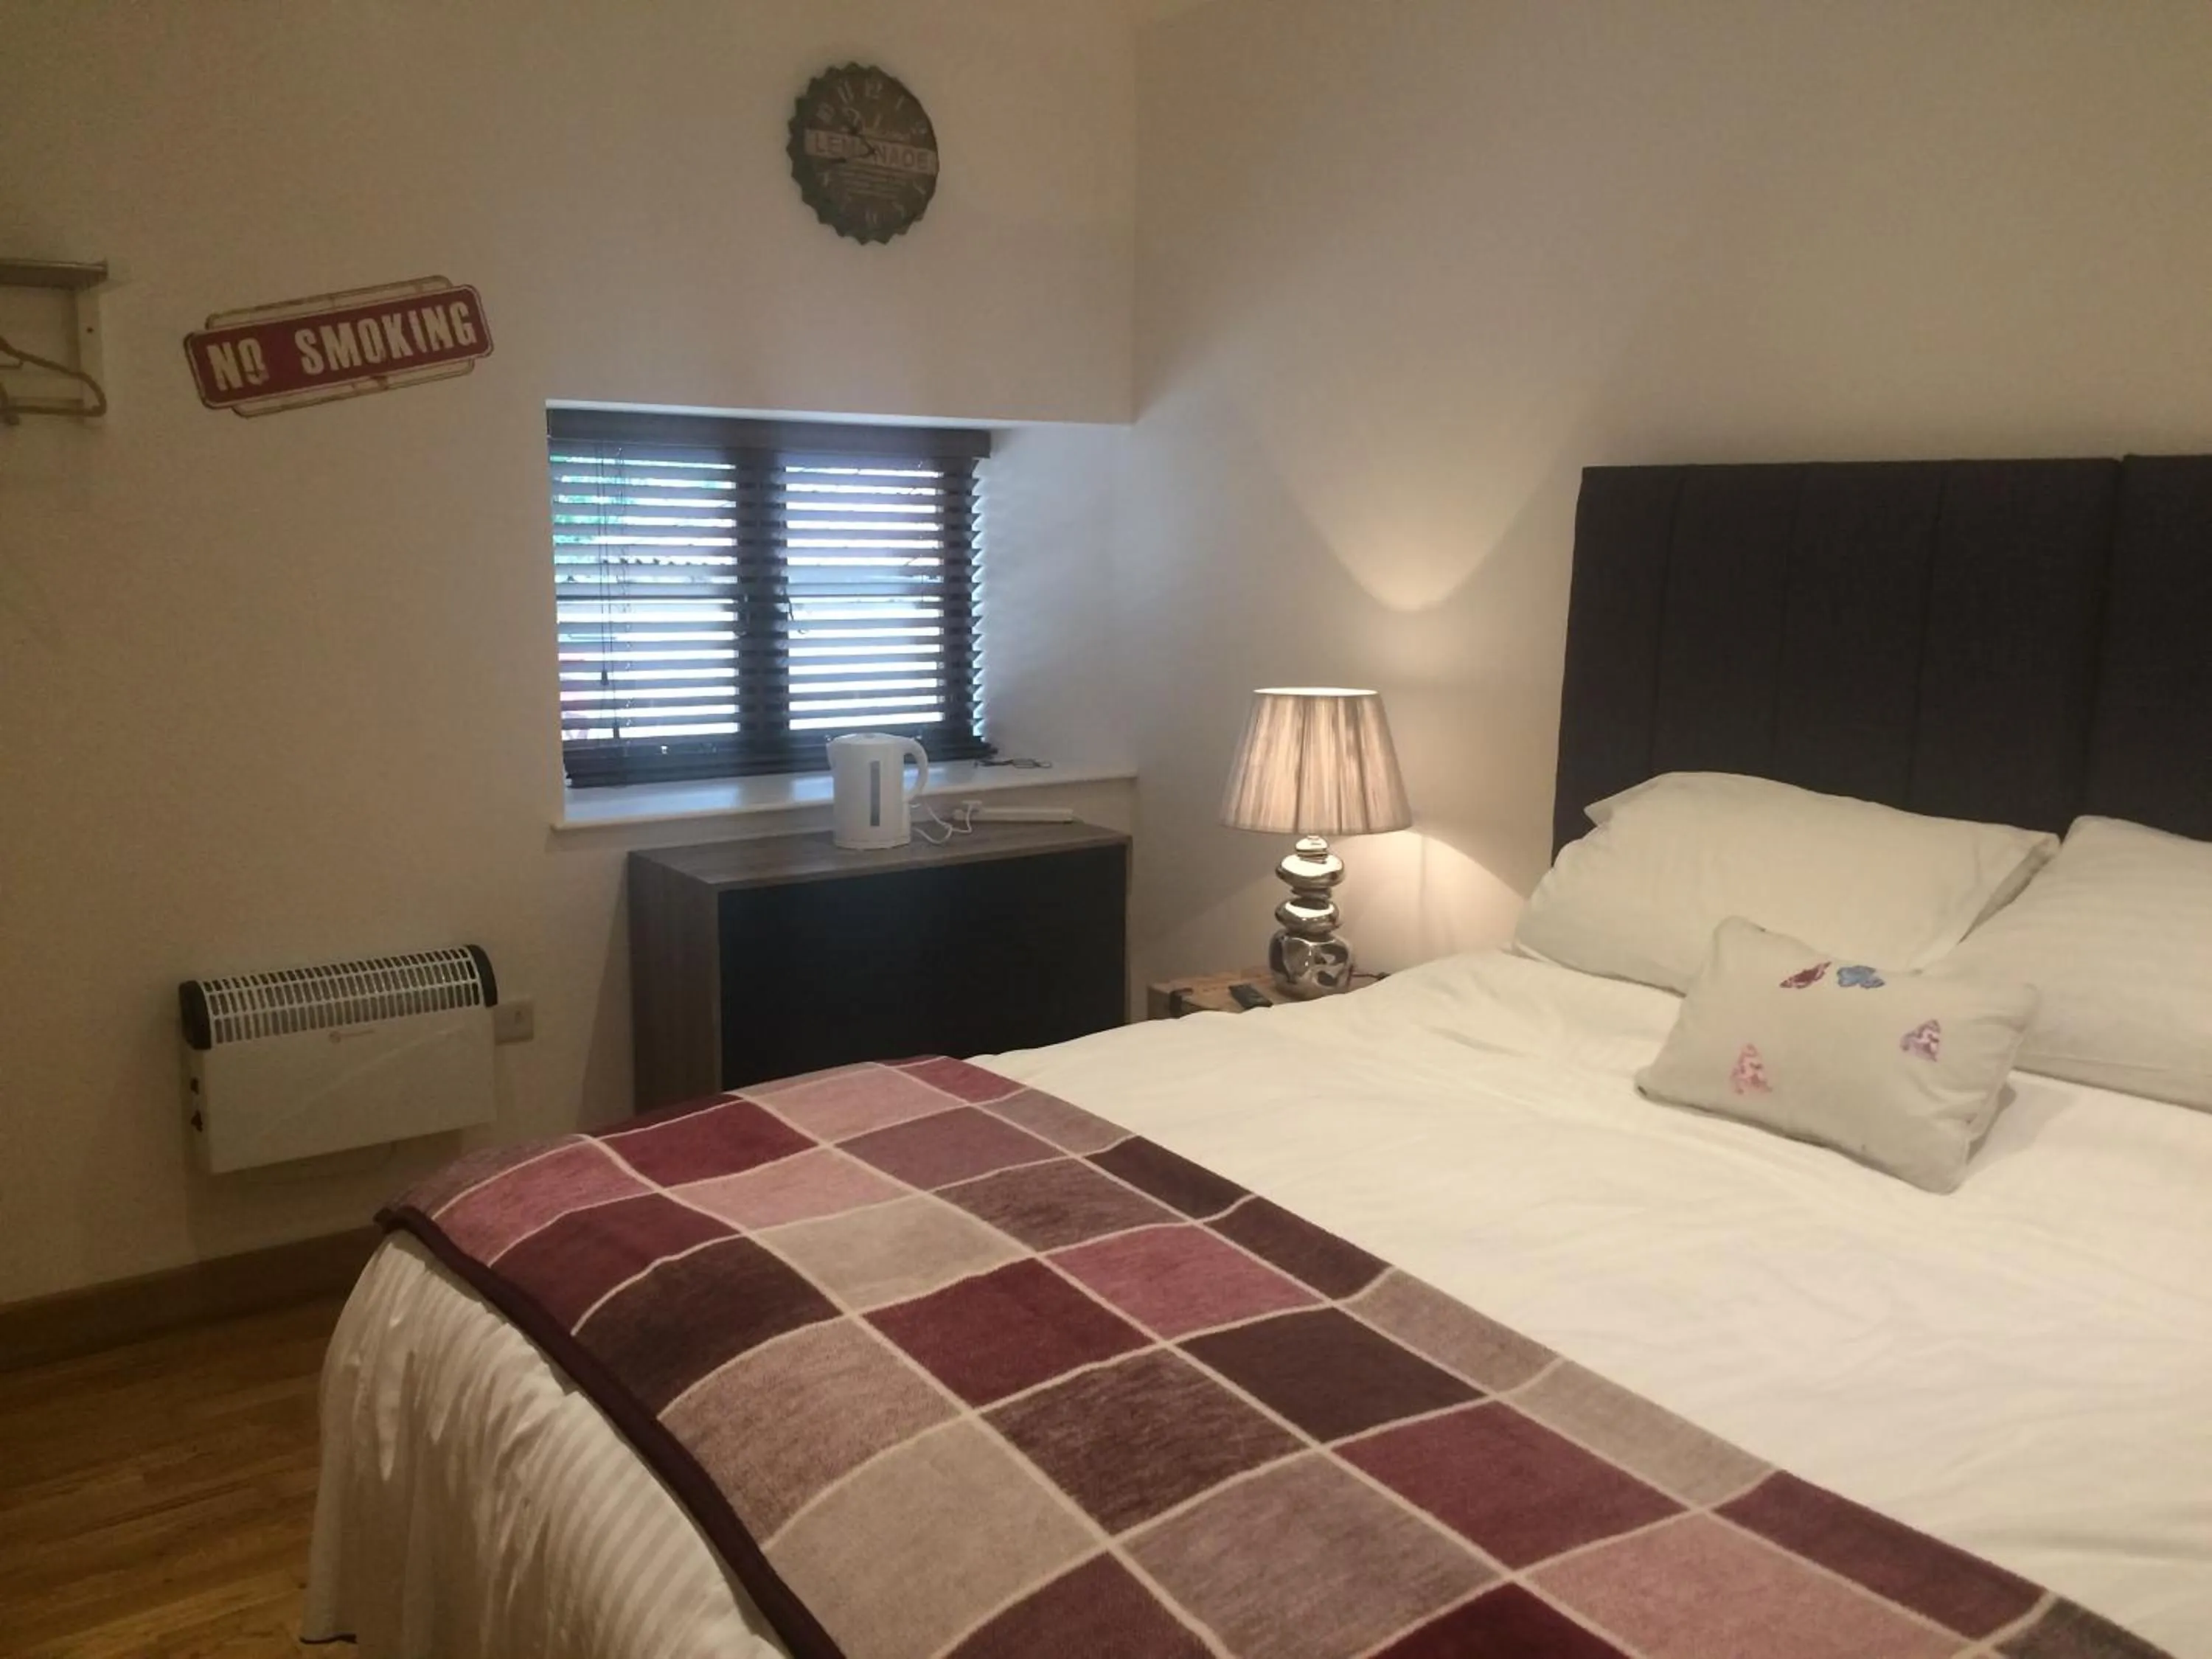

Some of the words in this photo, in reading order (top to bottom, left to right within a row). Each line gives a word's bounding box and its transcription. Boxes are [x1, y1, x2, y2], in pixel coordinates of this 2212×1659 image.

[814, 133, 928, 170] LEMNADE
[206, 337, 270, 392] NO
[295, 301, 478, 375] SMOKING
